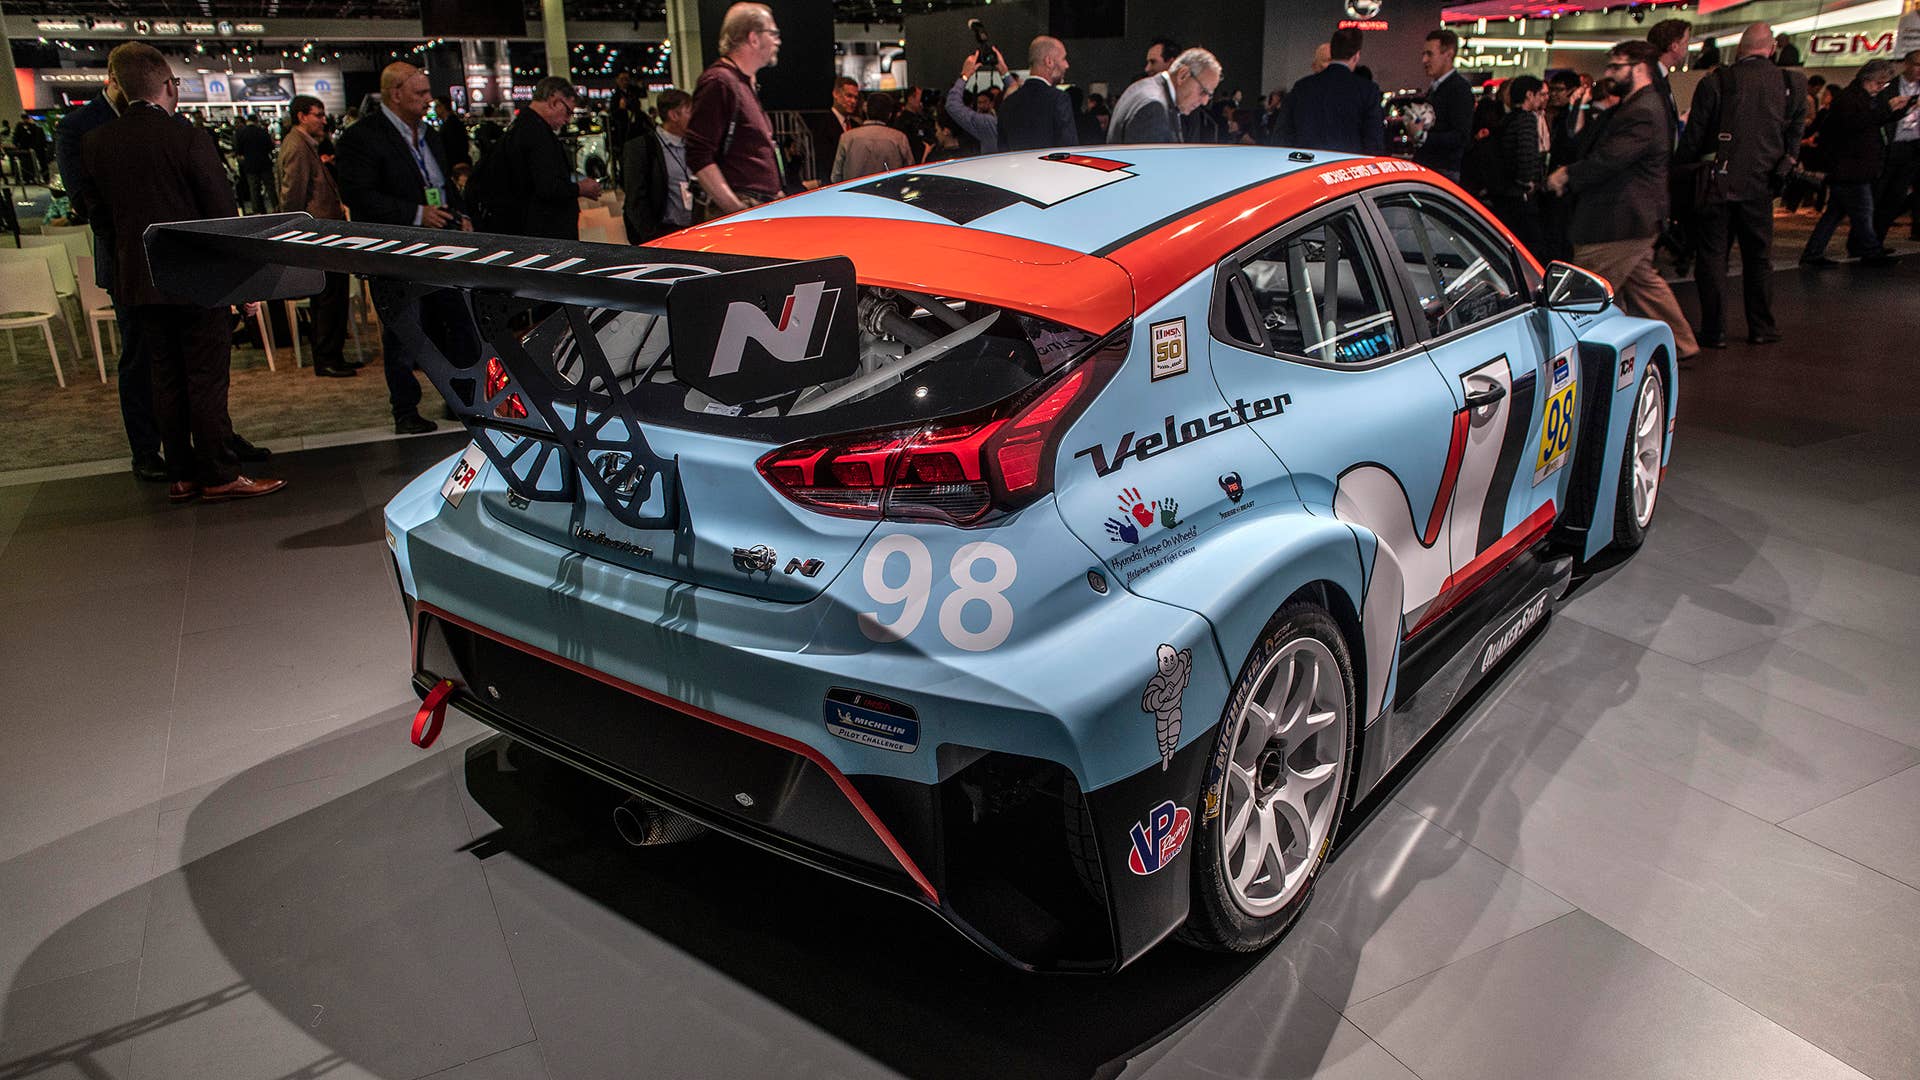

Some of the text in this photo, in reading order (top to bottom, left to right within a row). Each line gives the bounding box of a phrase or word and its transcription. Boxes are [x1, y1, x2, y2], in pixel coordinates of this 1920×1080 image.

[708, 281, 841, 377] N
[1156, 339, 1182, 363] 50
[1073, 393, 1293, 478] Veloster
[1544, 390, 1573, 462] 98
[451, 458, 477, 490] TCR
[1111, 527, 1198, 571] Hyundai Hope On Wheels
[857, 533, 1018, 652] 98
[839, 728, 860, 740] PILOT
[854, 716, 906, 735] MICHELIN
[1215, 653, 1262, 770] MICHELIN
[1129, 799, 1176, 873] VP
